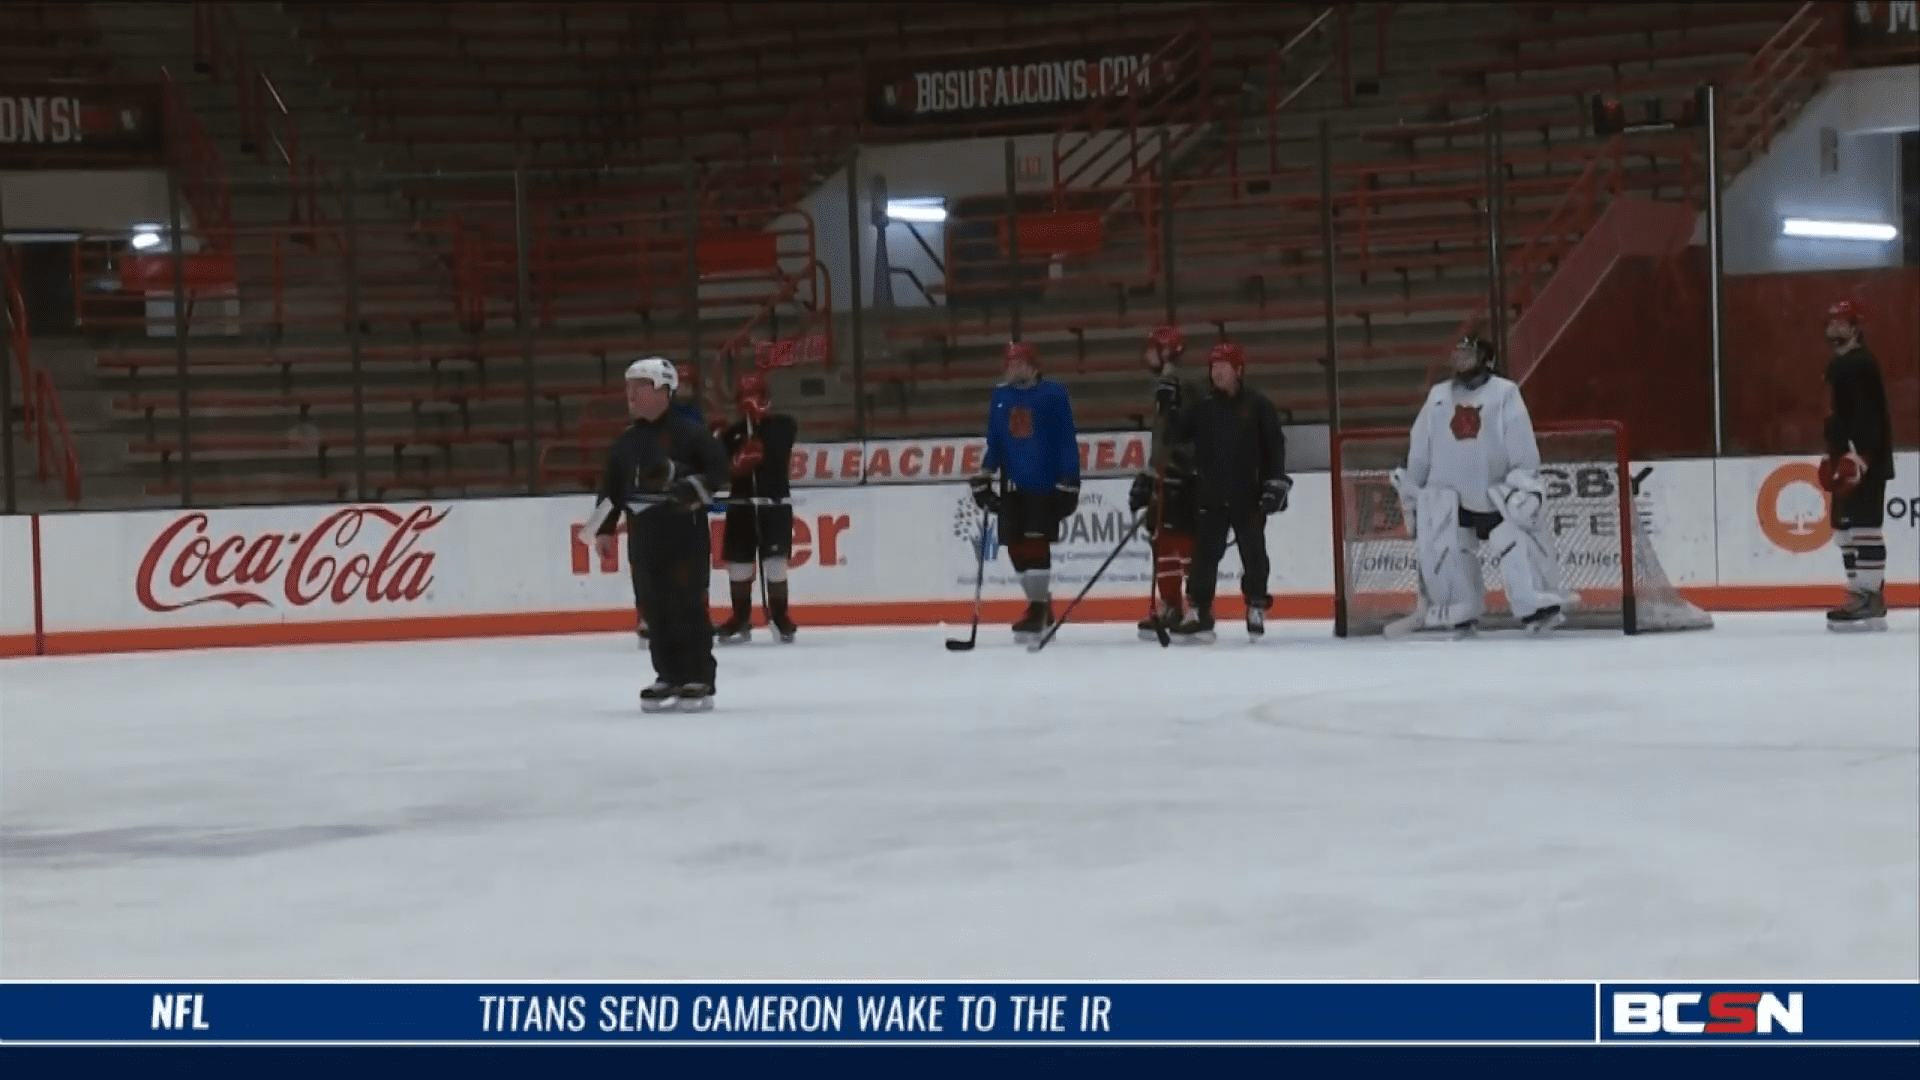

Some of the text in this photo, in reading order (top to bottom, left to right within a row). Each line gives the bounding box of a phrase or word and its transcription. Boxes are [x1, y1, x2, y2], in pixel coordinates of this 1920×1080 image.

[914, 53, 1151, 113] BGSUFALCONS.COM
[790, 443, 985, 480] BLEACHE
[135, 504, 454, 612] Coca-Cola
[1363, 554, 1419, 572] Officia
